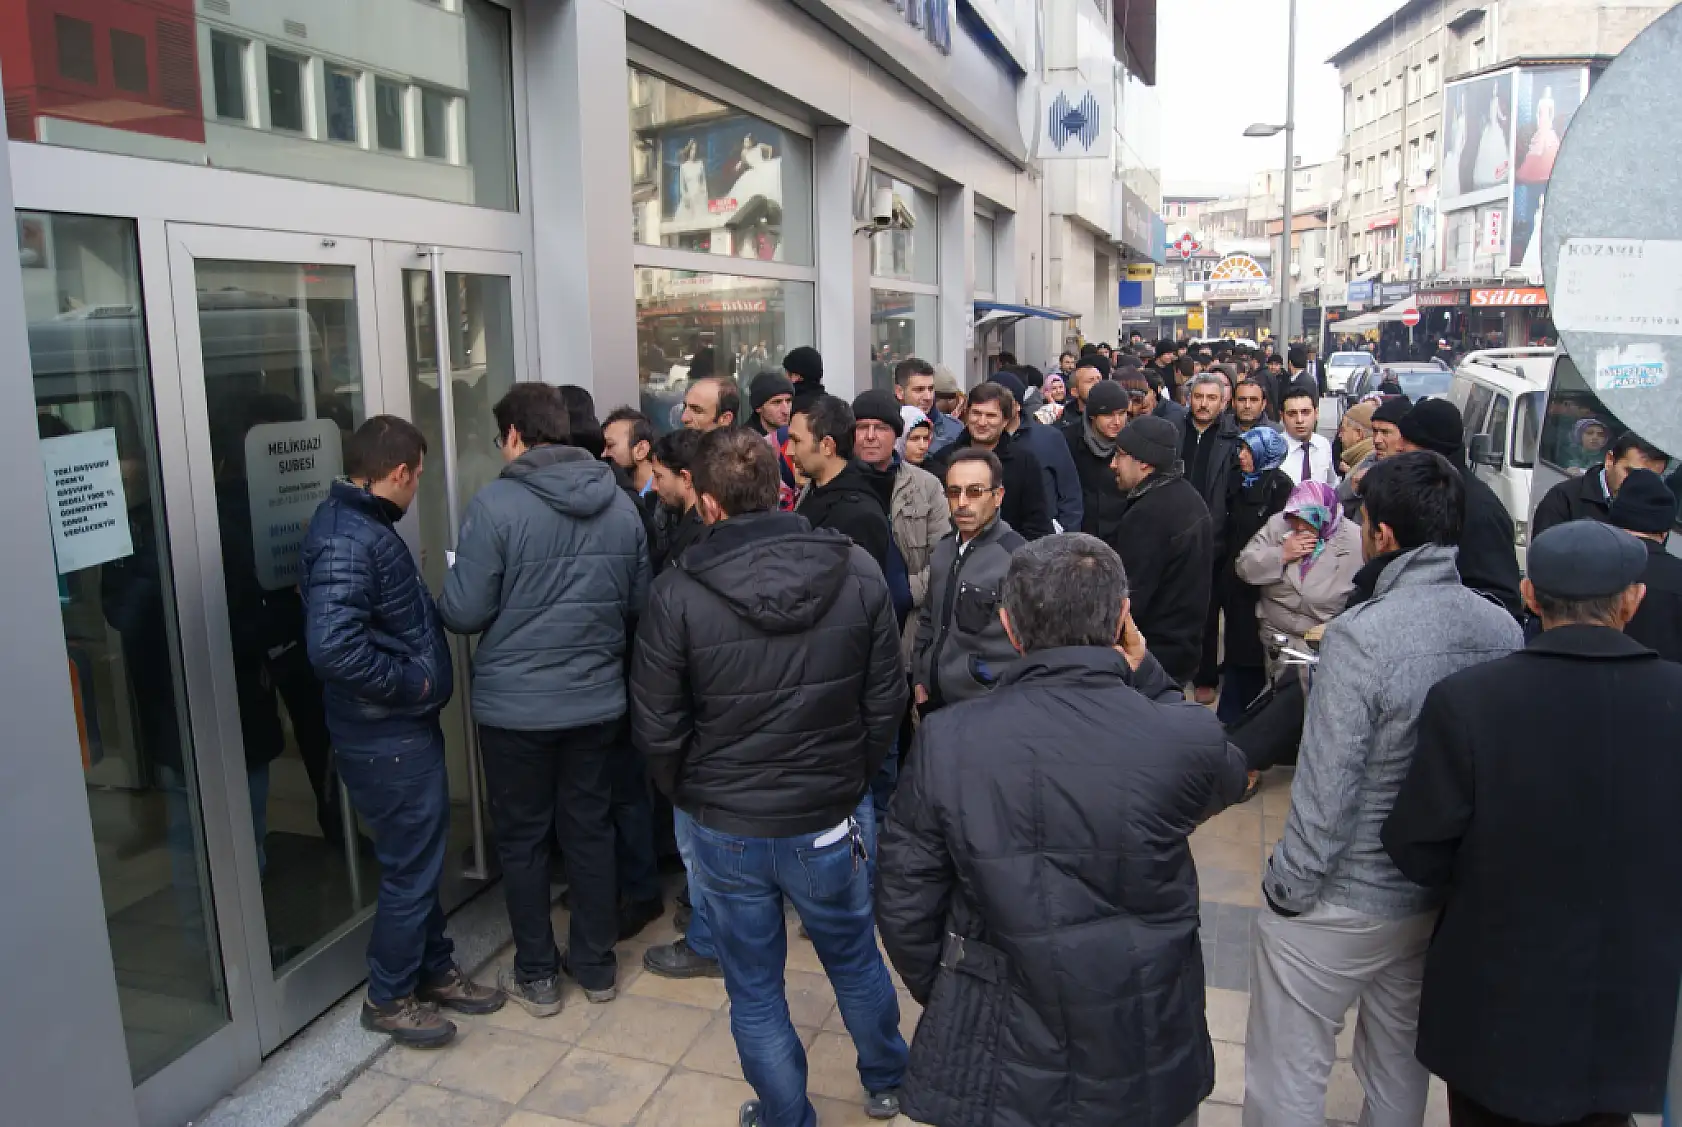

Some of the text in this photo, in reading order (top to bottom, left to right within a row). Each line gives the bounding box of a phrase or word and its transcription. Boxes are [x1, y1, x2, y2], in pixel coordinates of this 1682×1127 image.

[1474, 289, 1537, 305] Süha
[268, 434, 321, 456] MELİKGAZİ
[278, 454, 315, 474] ŞUBESİ
